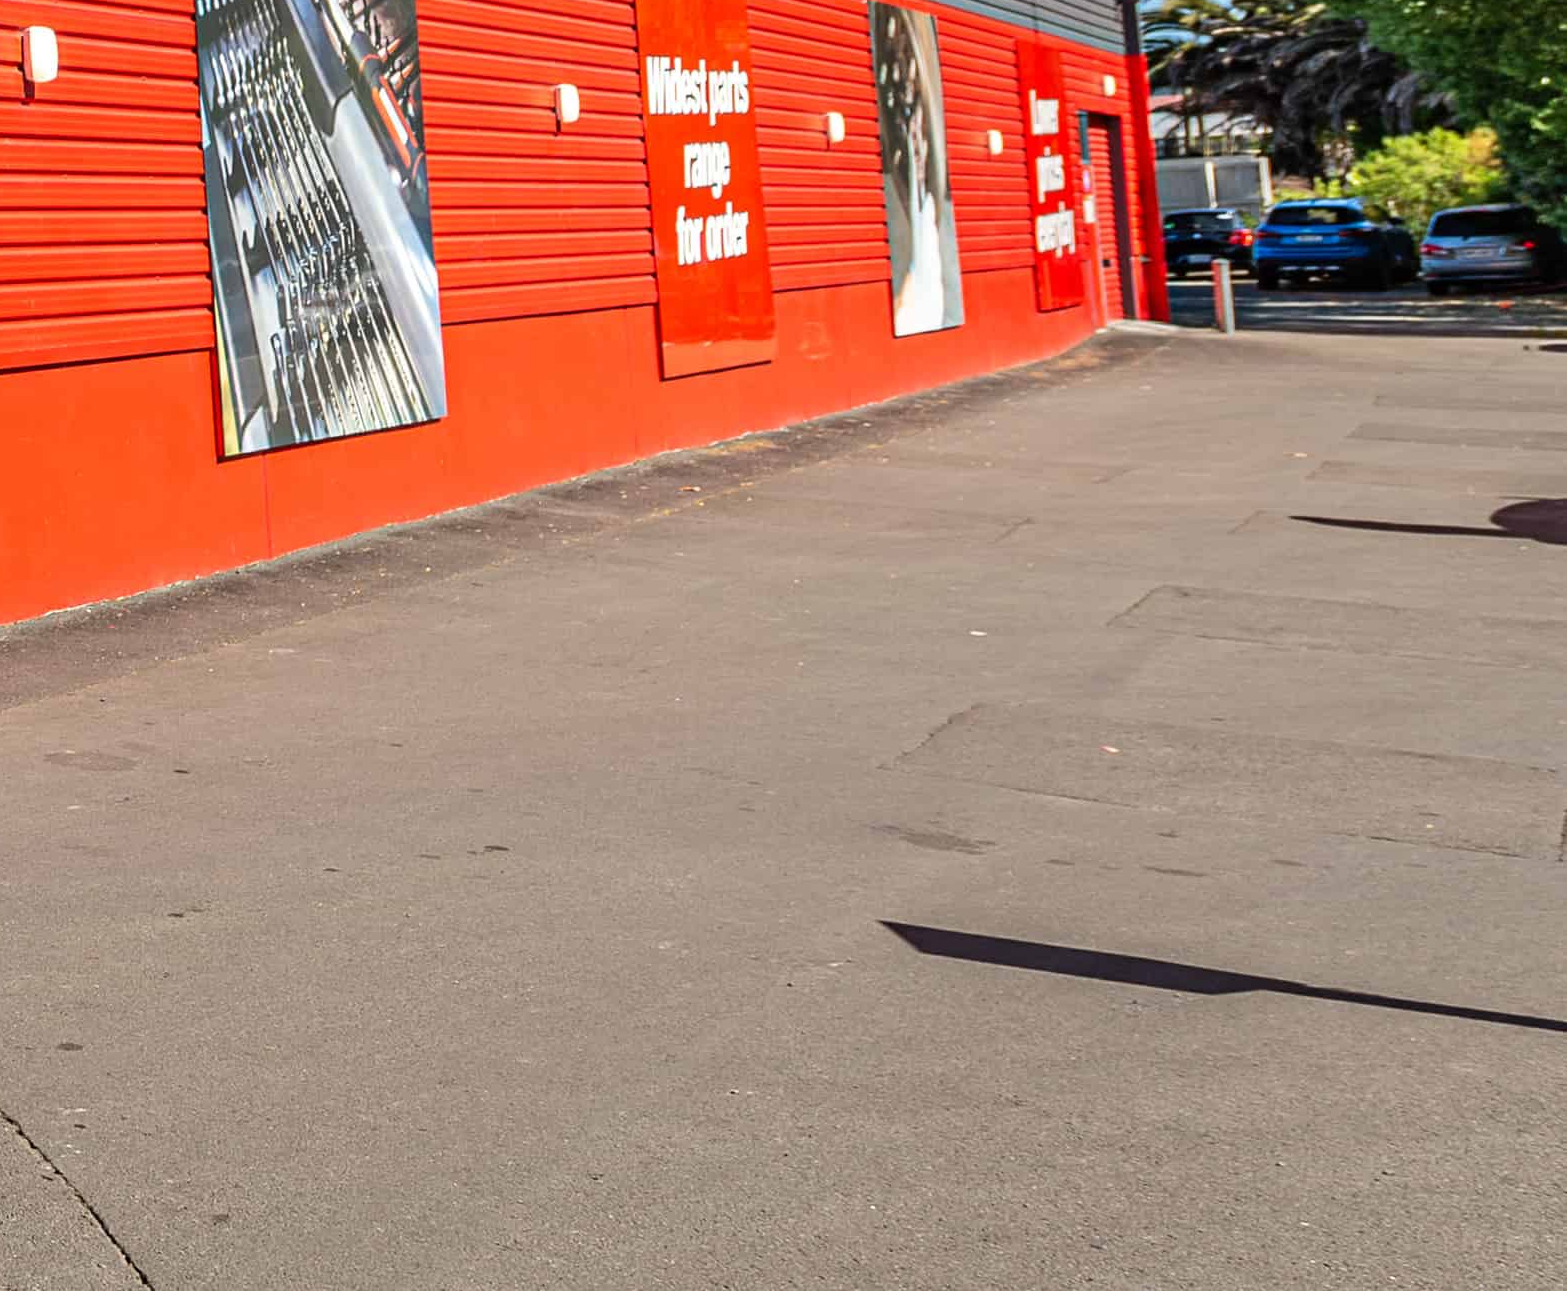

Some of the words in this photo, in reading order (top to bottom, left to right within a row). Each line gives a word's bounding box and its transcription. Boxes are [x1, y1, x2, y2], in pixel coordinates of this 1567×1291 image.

[646, 56, 708, 115] Widest
[708, 60, 750, 126] parts
[683, 141, 731, 199] range
[676, 206, 704, 266] for
[705, 201, 749, 261] order
